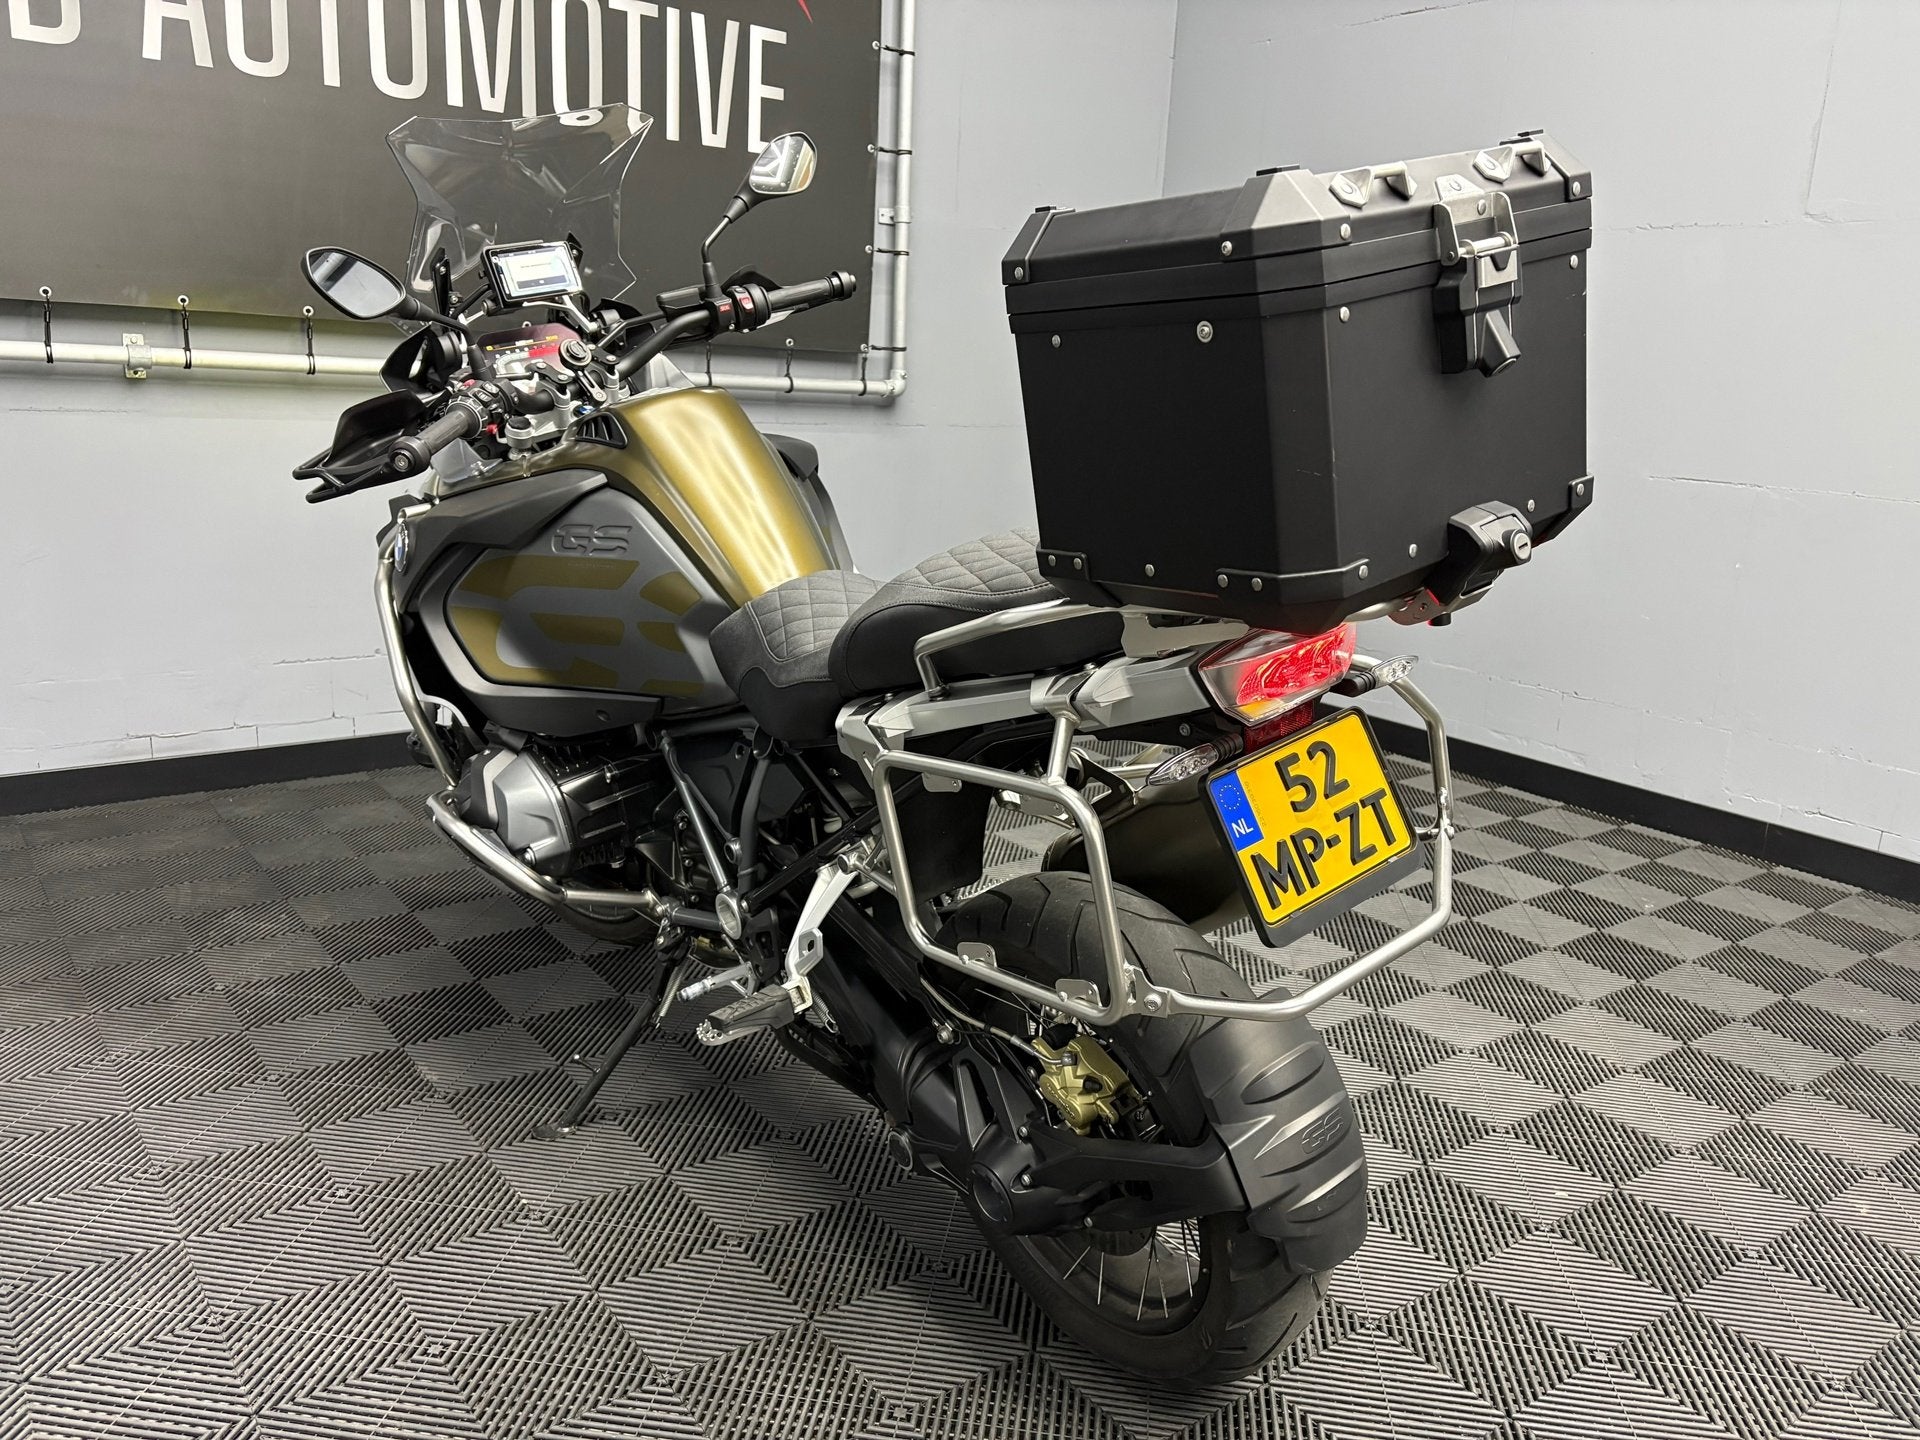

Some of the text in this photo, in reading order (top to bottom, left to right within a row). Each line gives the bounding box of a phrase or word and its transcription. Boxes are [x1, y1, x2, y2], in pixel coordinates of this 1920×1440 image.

[142, 0, 787, 154] AUTOMOTIVE
[551, 524, 632, 557] GS
[1274, 740, 1350, 813] 52
[1231, 817, 1254, 838] NL
[1250, 787, 1397, 911] MP-ZT
[1301, 1106, 1344, 1155] GS
